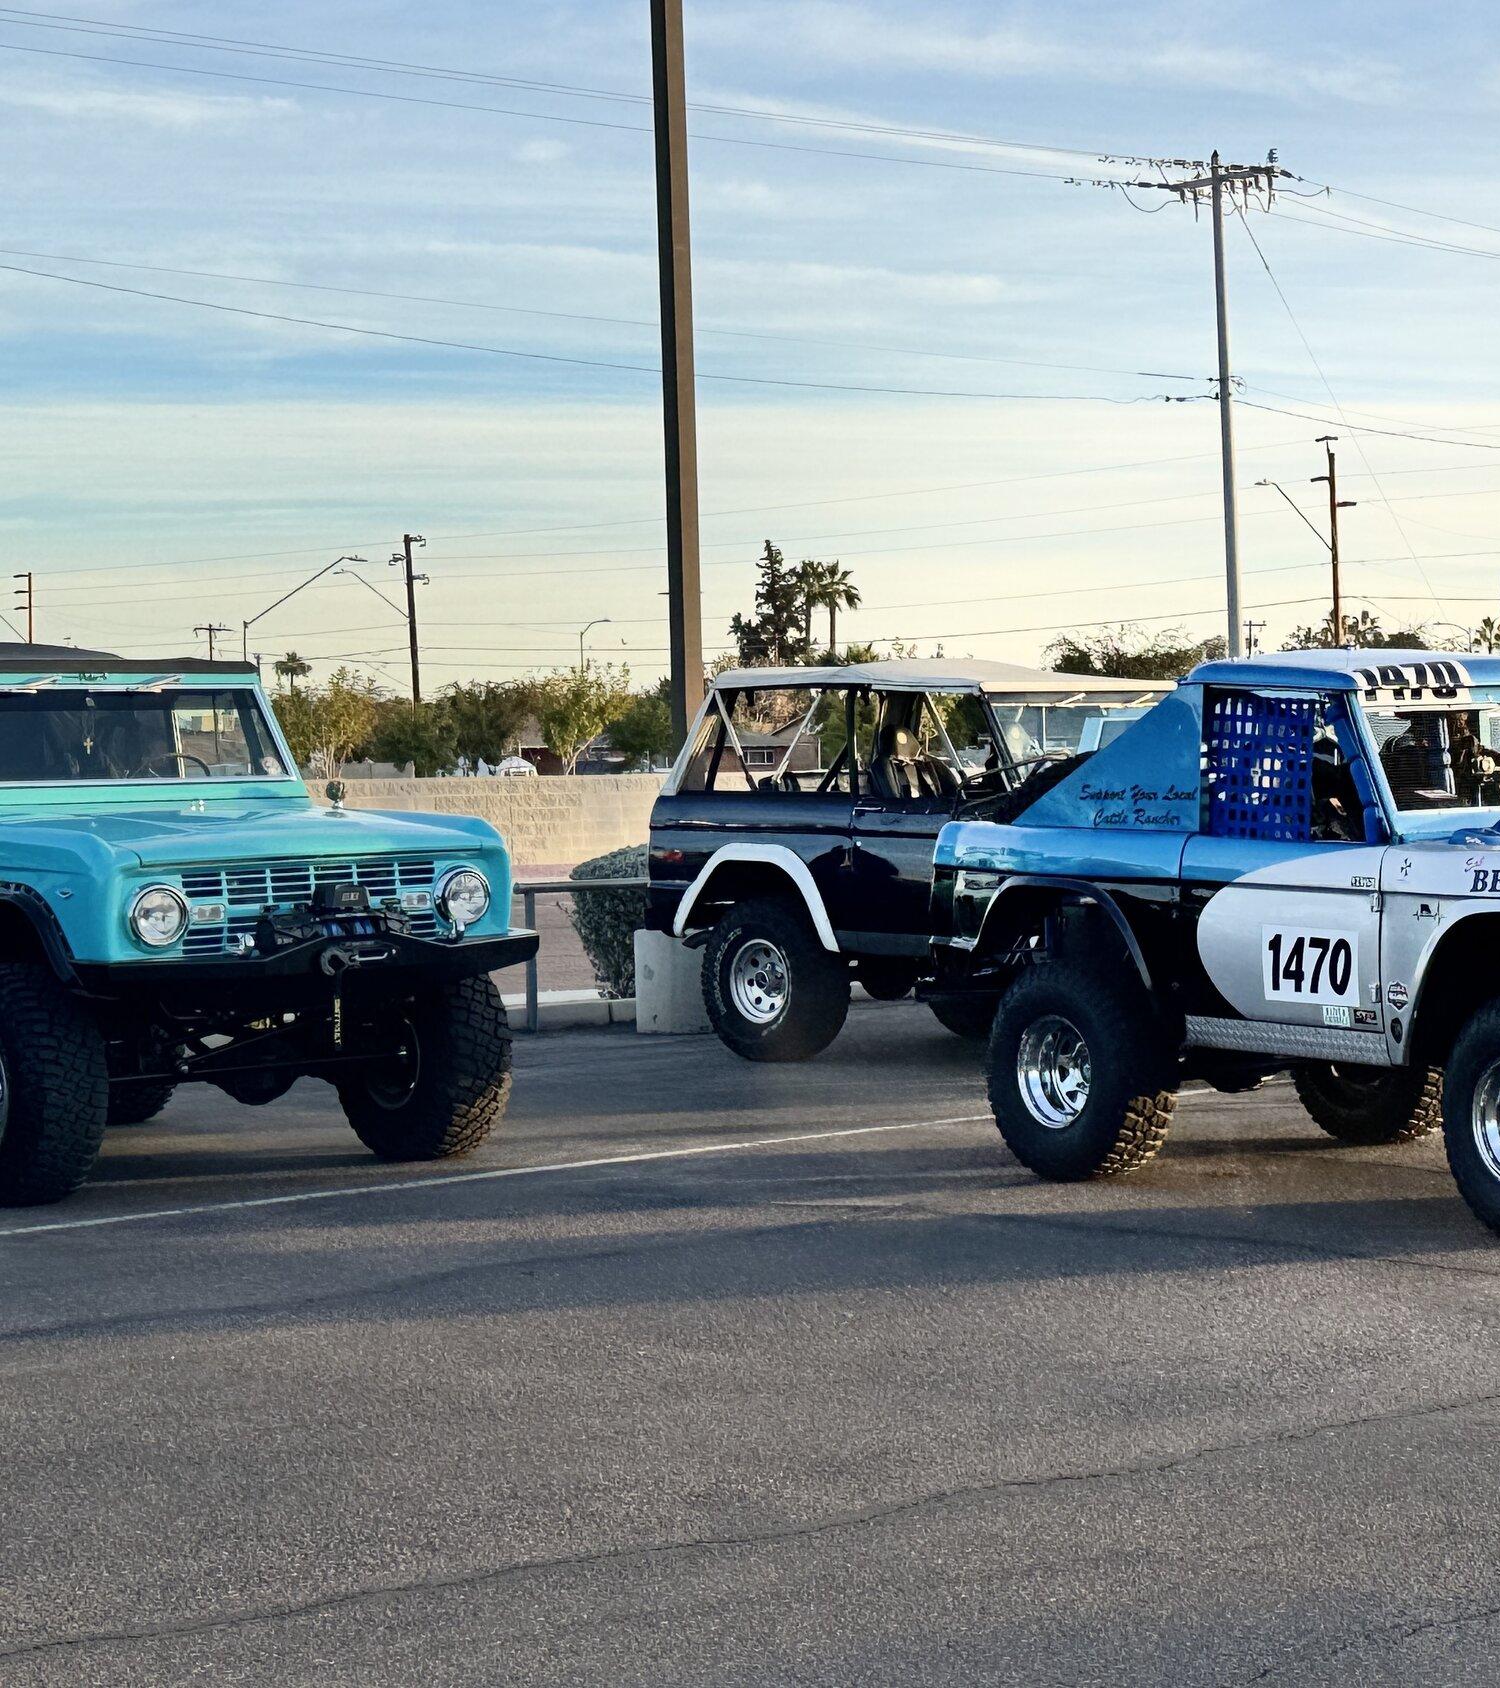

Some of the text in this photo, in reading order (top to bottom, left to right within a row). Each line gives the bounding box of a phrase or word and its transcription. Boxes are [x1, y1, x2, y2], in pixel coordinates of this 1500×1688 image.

[1353, 661, 1464, 701] 1470
[1080, 784, 1198, 806] Support Your Local
[1093, 808, 1128, 827] Cattle
[1268, 933, 1352, 996] 1470
